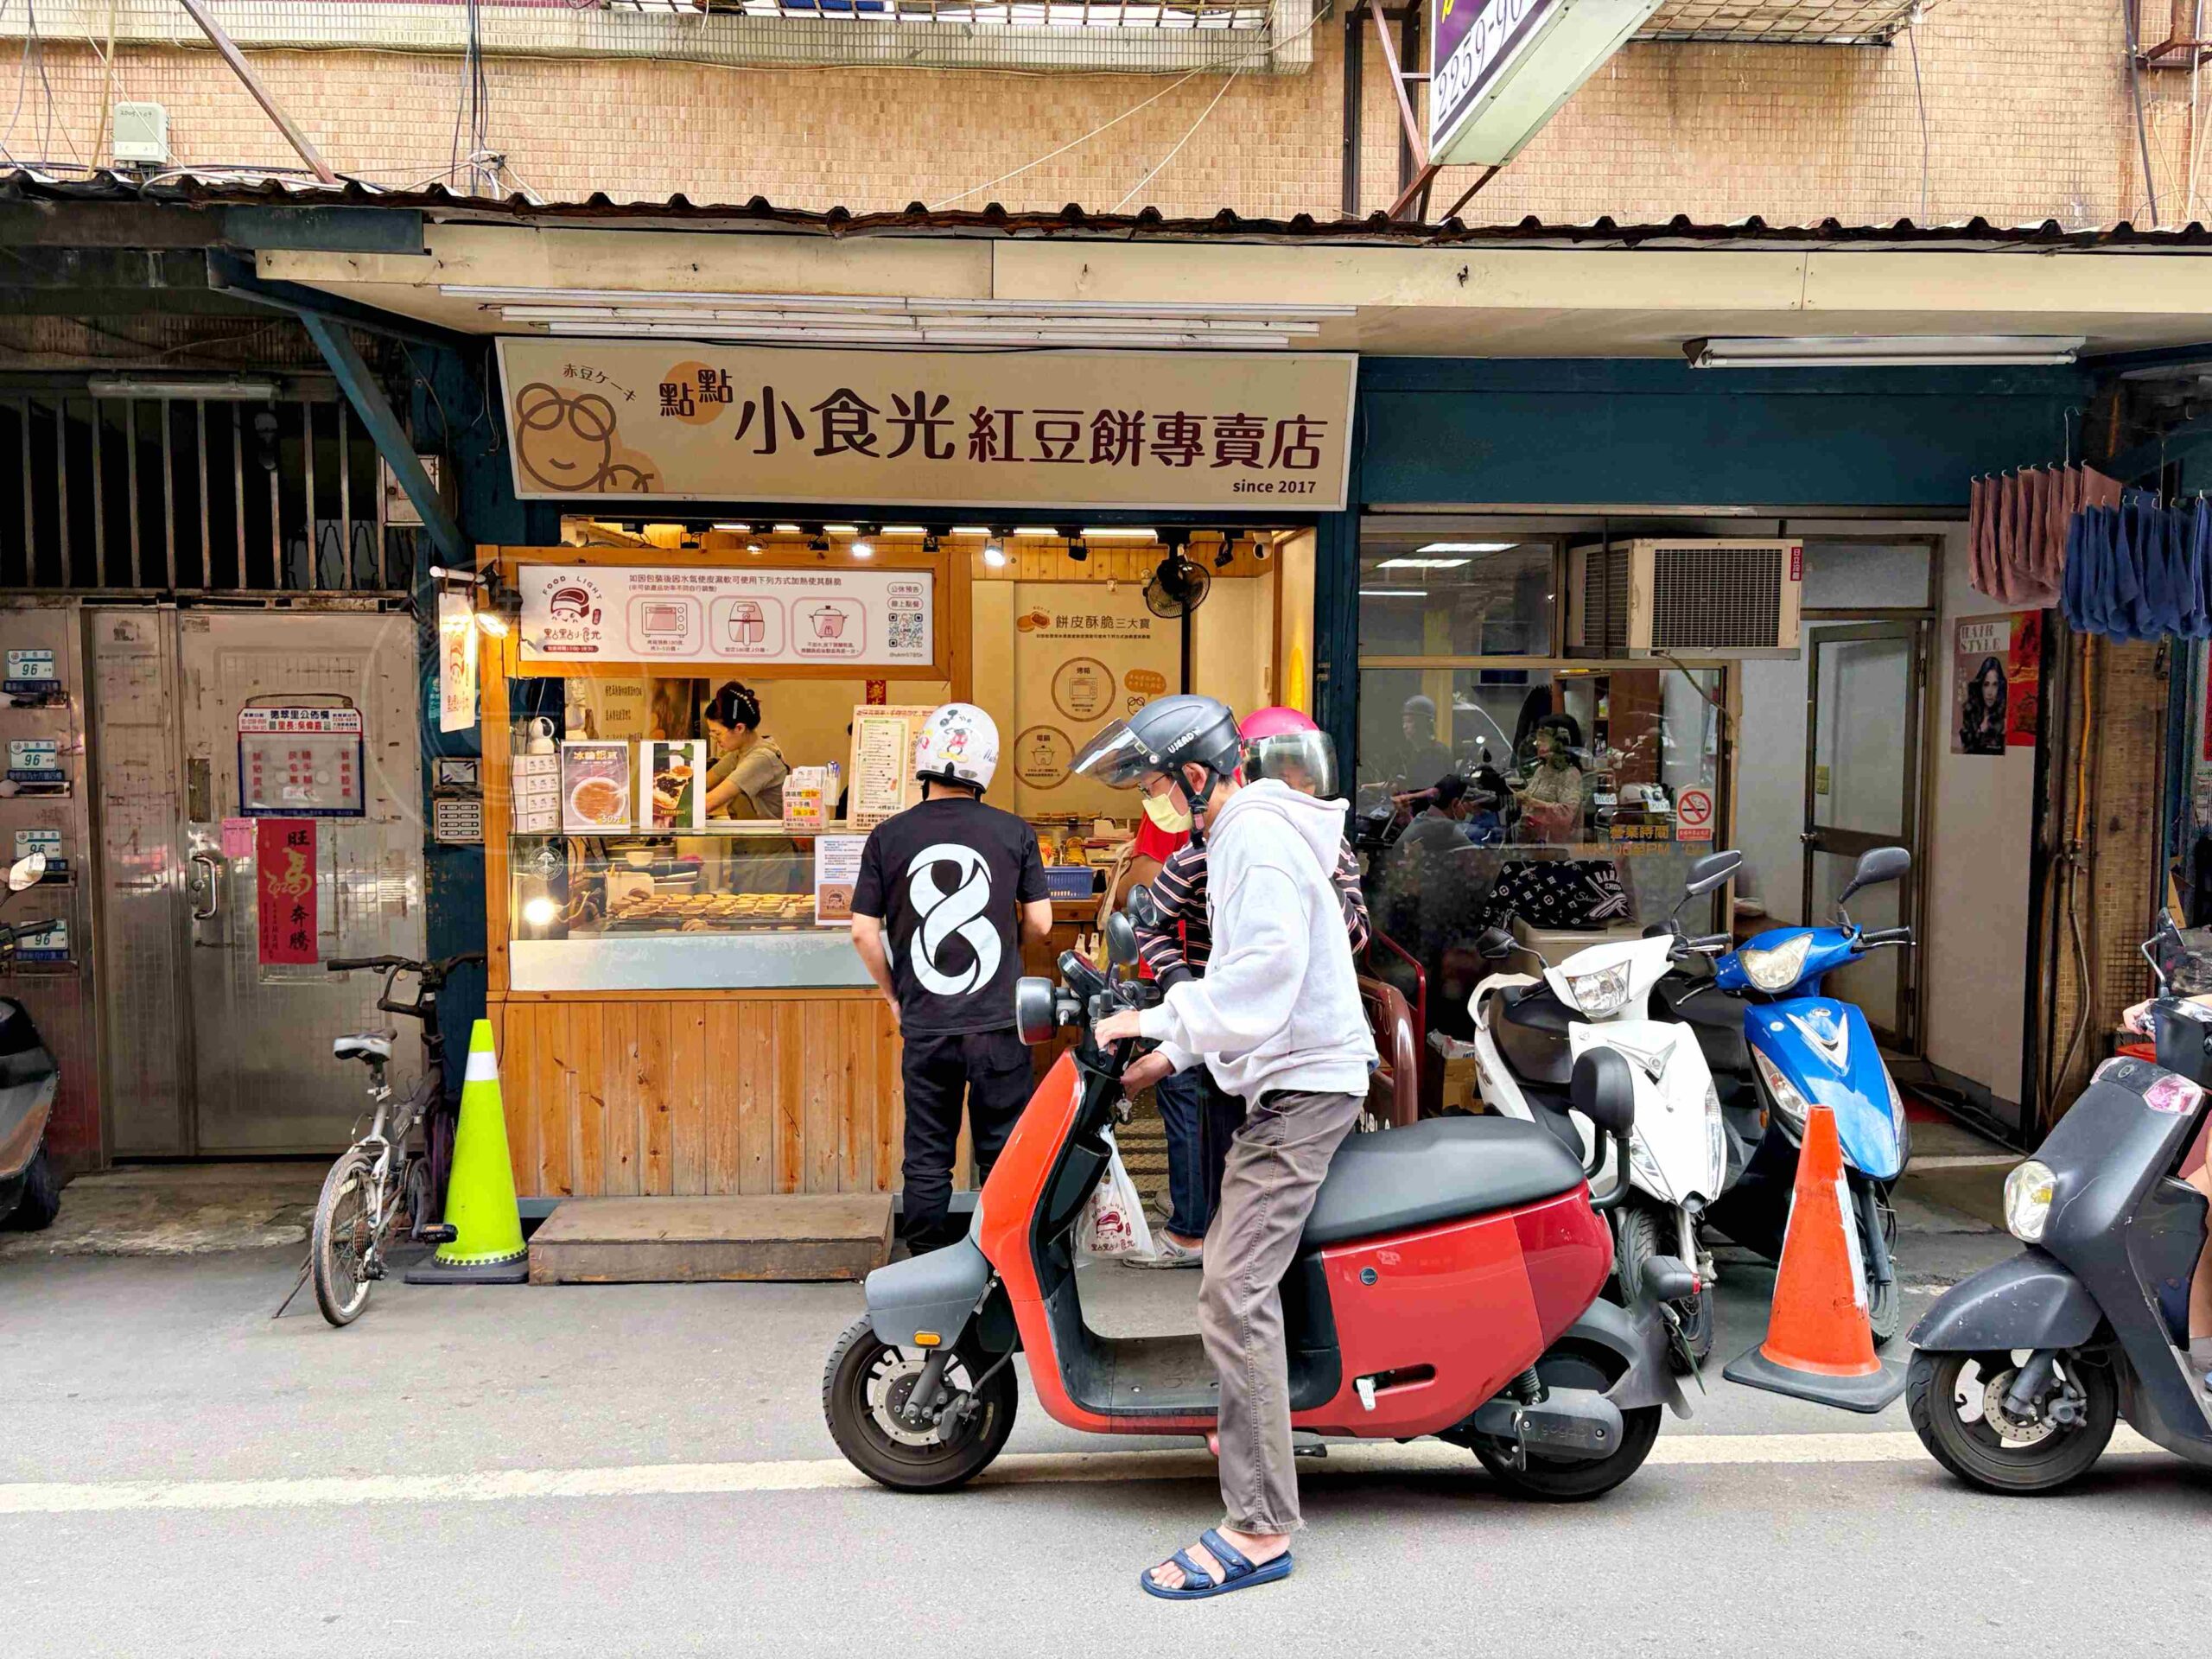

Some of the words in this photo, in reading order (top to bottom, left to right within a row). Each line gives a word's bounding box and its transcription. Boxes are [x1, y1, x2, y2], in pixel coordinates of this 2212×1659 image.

[563, 362, 637, 402] 赤豆ケーキ
[1232, 479, 1274, 493] since
[1278, 480, 1317, 494] 2017
[543, 575, 567, 595] FOOD
[576, 575, 602, 601] LIGHT
[1056, 614, 1150, 630] 餅皮酥脆三大寶
[1961, 624, 1994, 639] HAIR
[1960, 638, 2001, 652] STYLE
[22, 664, 38, 676] 96
[24, 754, 41, 766] 96
[35, 933, 51, 945] 96
